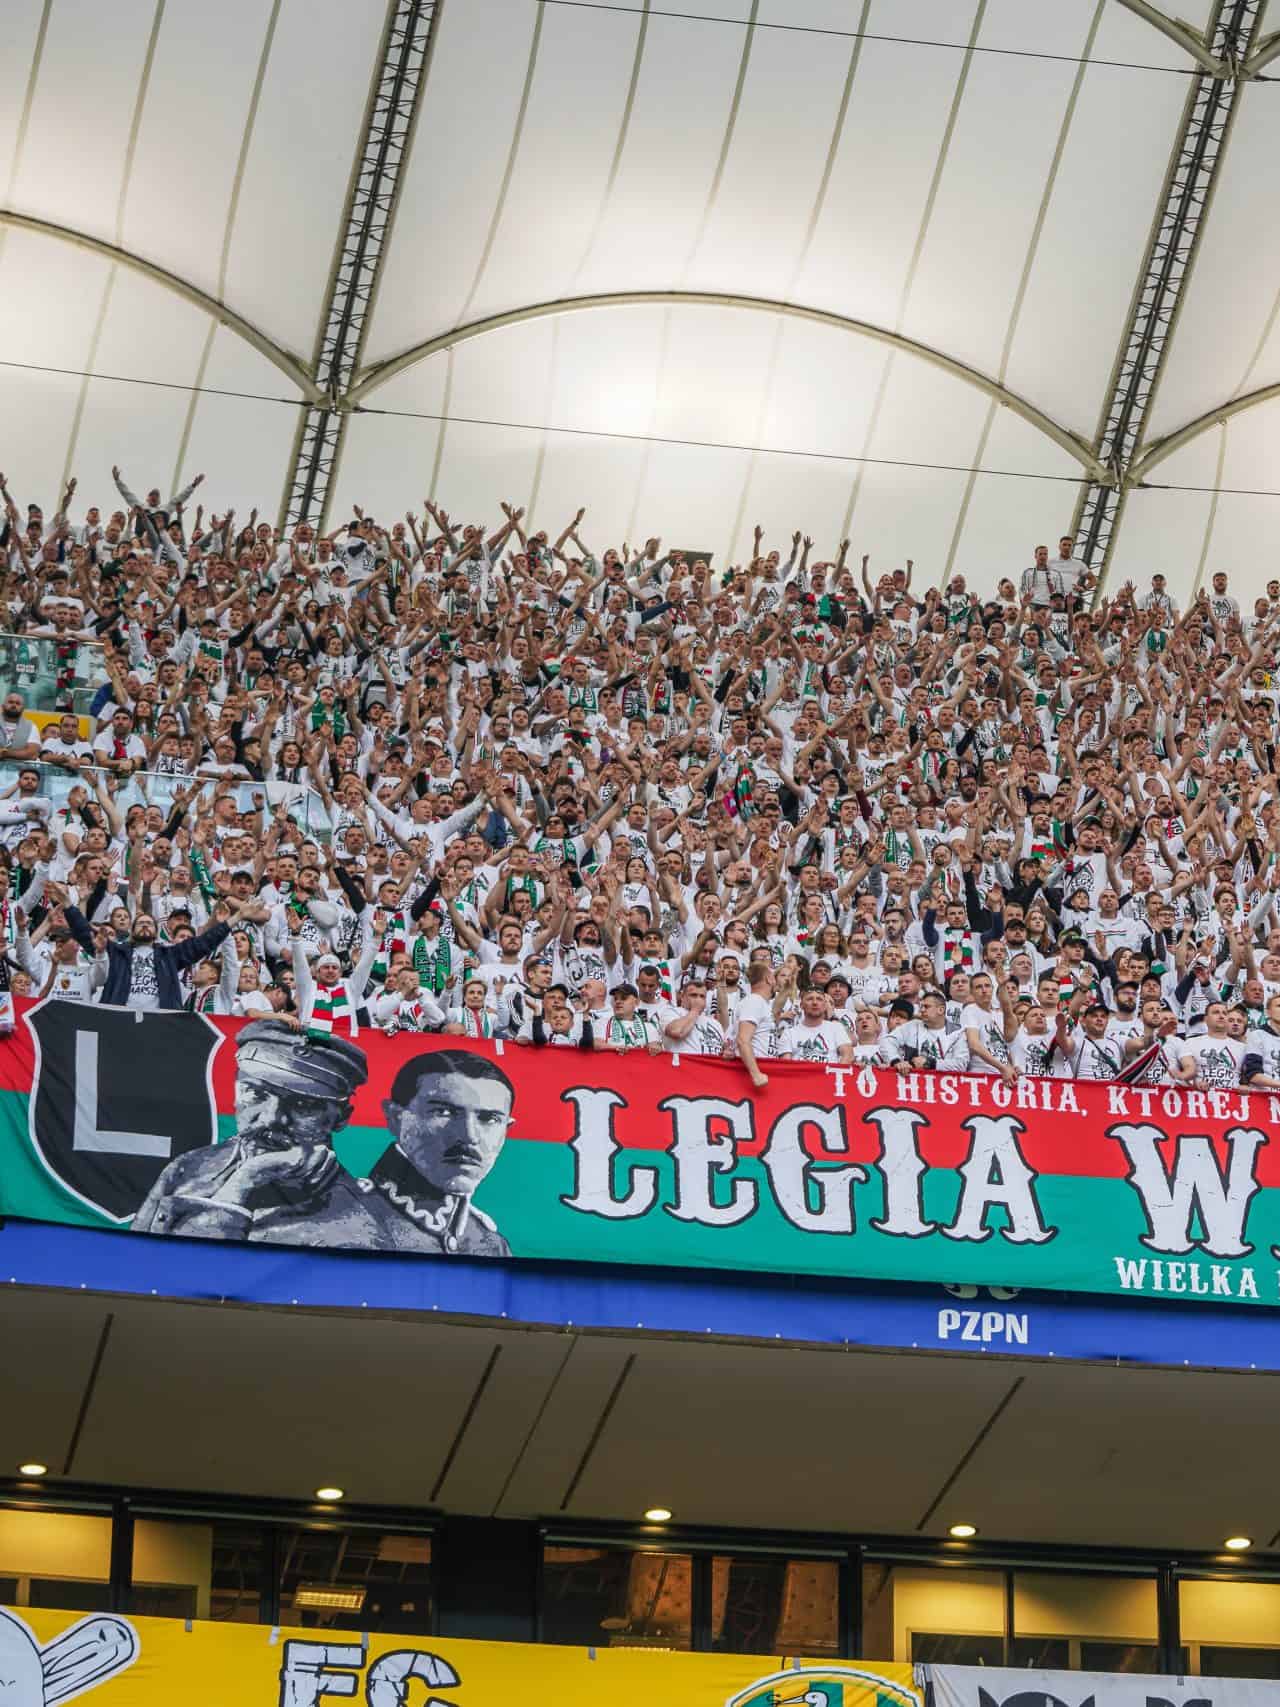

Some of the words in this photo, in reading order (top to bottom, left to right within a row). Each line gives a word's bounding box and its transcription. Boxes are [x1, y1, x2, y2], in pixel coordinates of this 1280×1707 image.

[73, 1030, 172, 1158] L
[826, 1066, 878, 1098] TO
[896, 1073, 1088, 1117] HISTORIA,
[1106, 1084, 1250, 1122] KTÓREJ
[560, 1087, 1058, 1244] LEGIA
[1113, 1256, 1260, 1299] WIELKA
[938, 1308, 1028, 1345] PZPN
